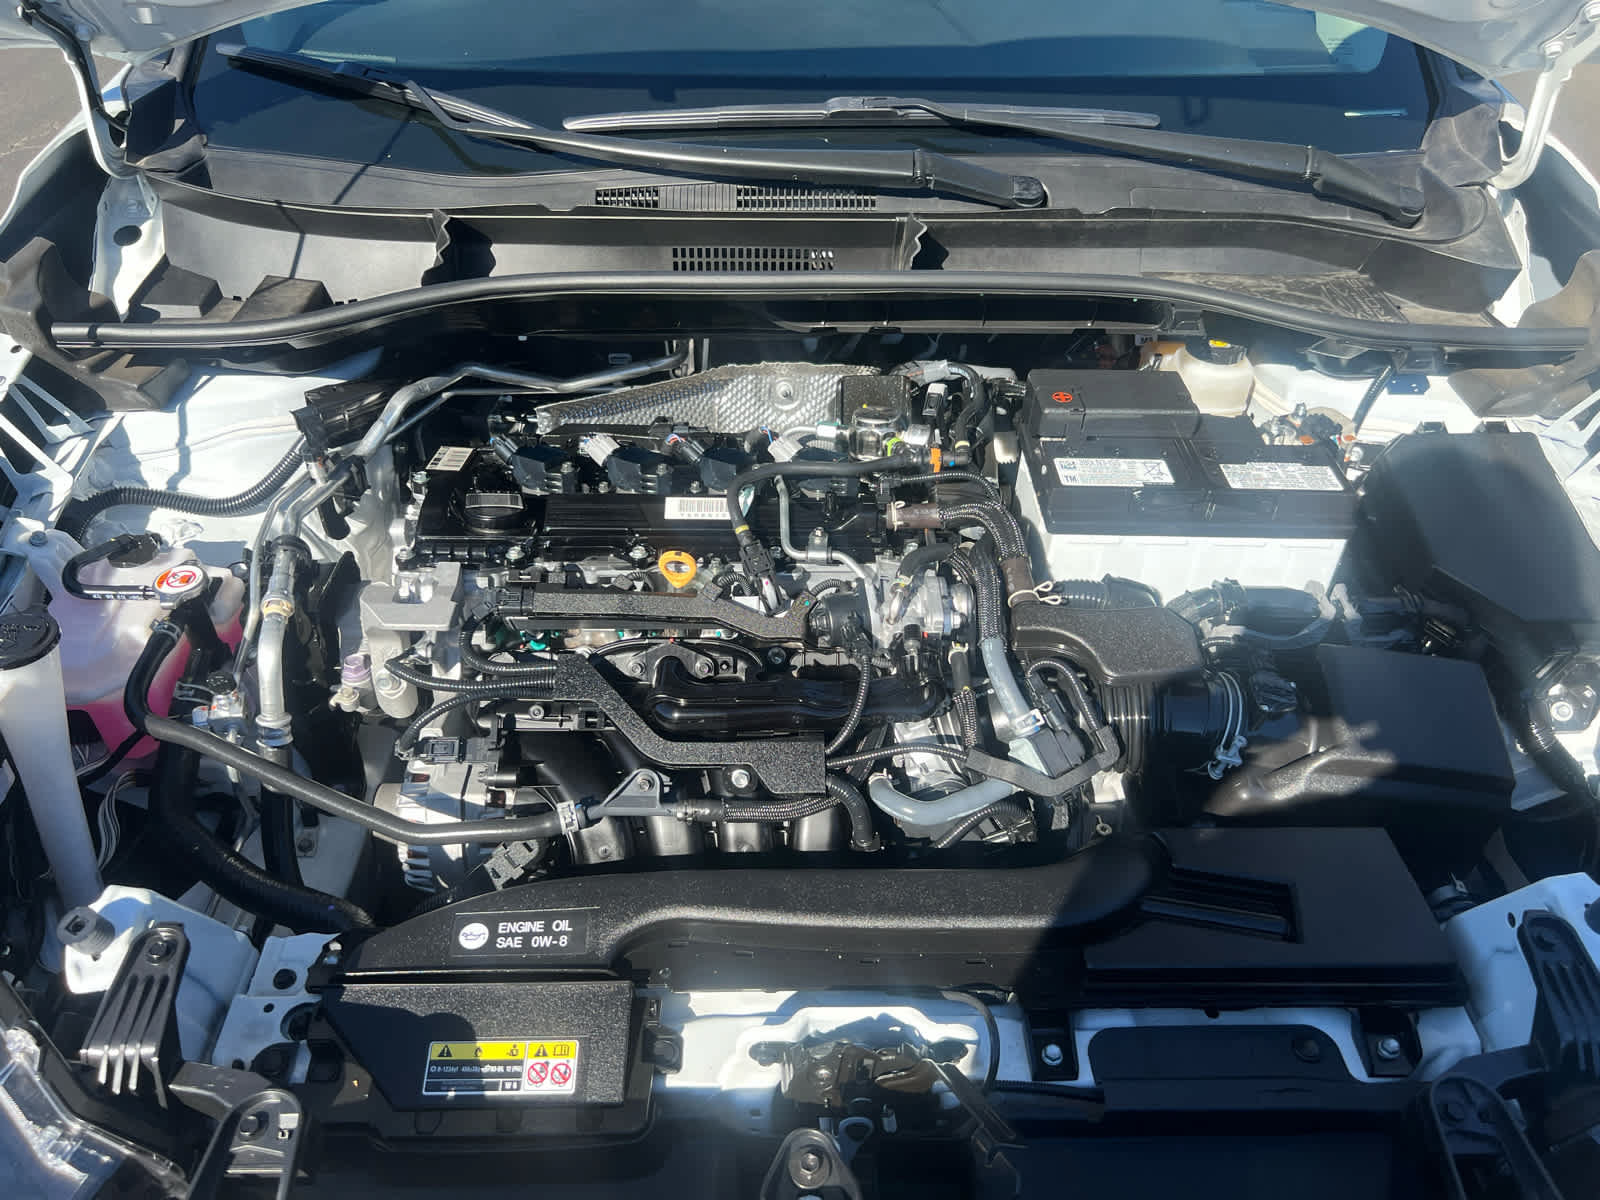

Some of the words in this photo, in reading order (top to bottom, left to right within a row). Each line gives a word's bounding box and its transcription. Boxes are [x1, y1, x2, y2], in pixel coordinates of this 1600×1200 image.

[498, 921, 544, 933] ENGINE
[552, 920, 573, 932] OIL
[496, 936, 523, 948] SAE
[531, 935, 568, 947] 0W-8
